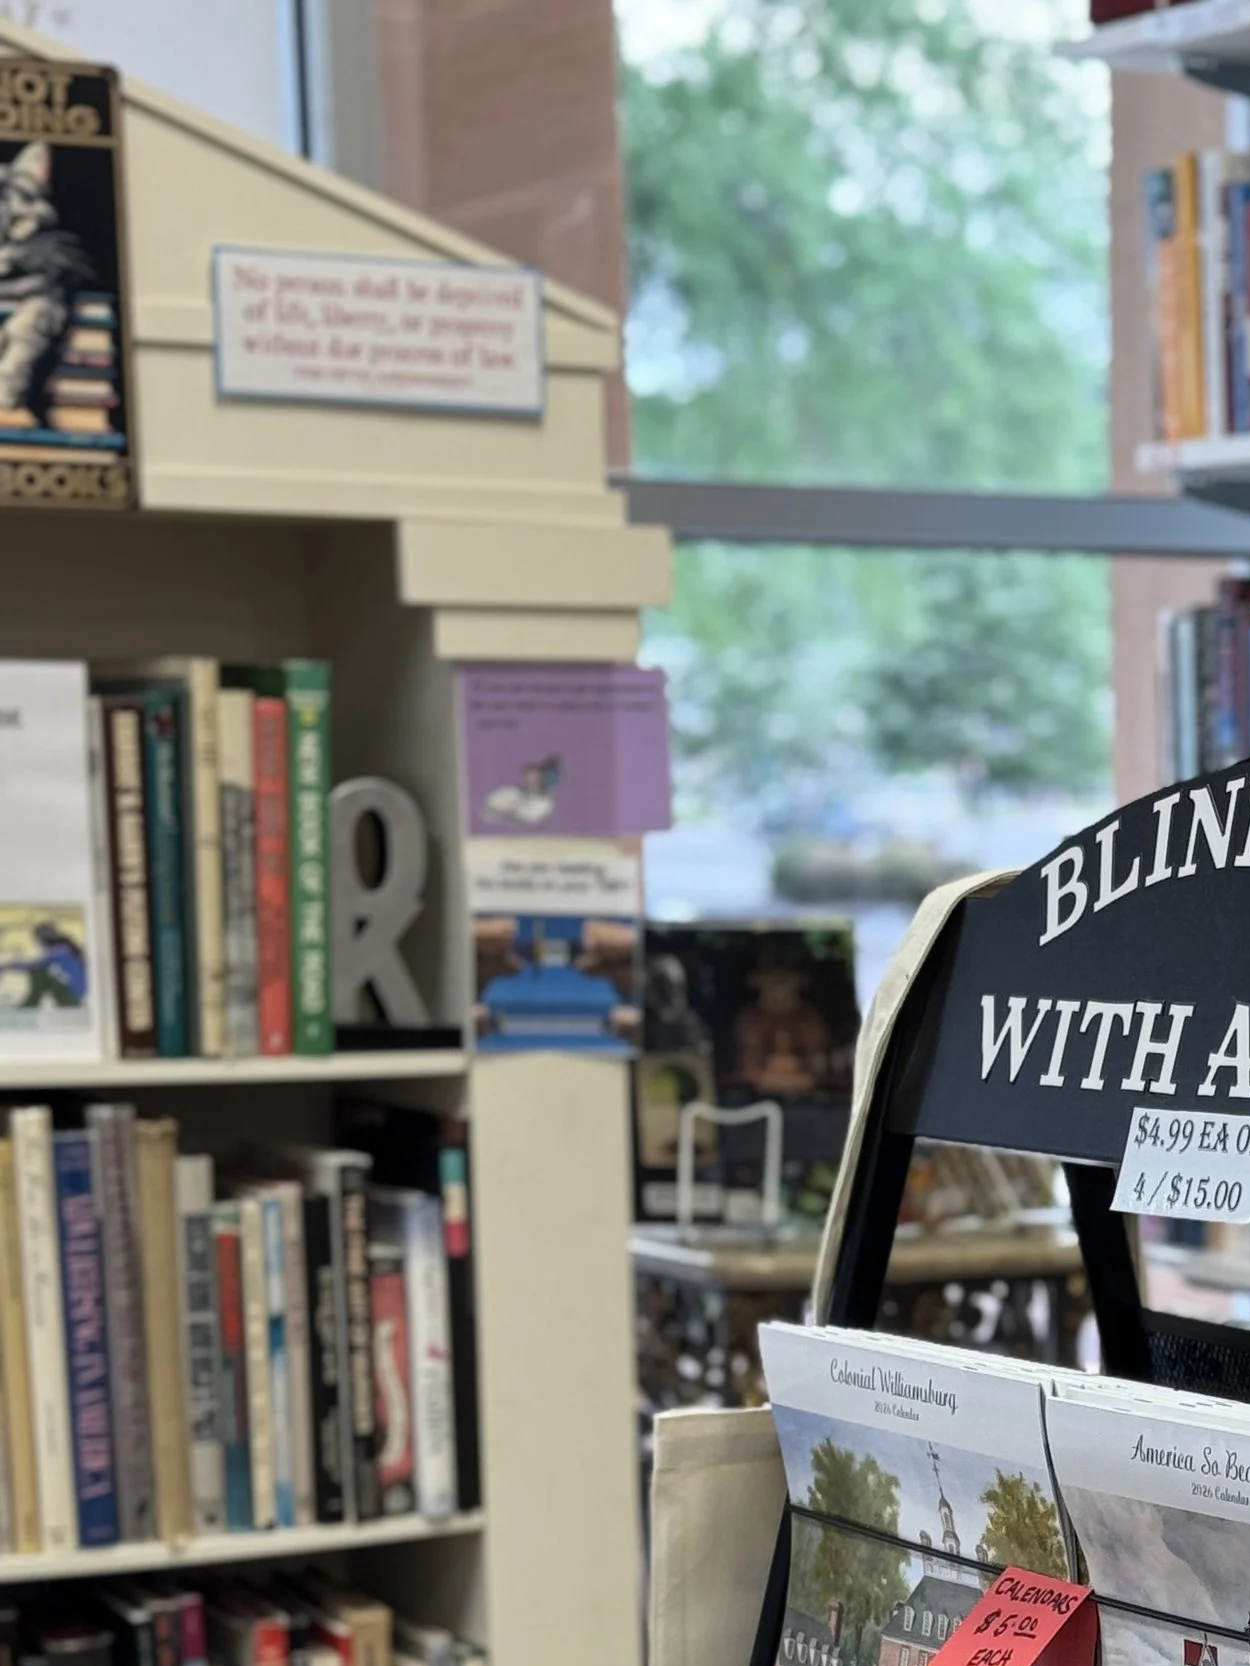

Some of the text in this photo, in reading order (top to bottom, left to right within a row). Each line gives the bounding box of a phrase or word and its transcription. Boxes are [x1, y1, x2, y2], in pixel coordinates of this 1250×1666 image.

[981, 995, 1194, 1095] WITH
[1135, 1113, 1194, 1154] $4.99
[1198, 1121, 1229, 1154] EA
[1133, 1173, 1146, 1202] 4
[1166, 1173, 1243, 1213] $15.00
[829, 1357, 958, 1415] Colonial Williamsburg
[1131, 1434, 1195, 1474] America
[1202, 1446, 1222, 1478] So
[1191, 1482, 1249, 1506] 2026 Calendar
[994, 1576, 1079, 1615] CALENDARS
